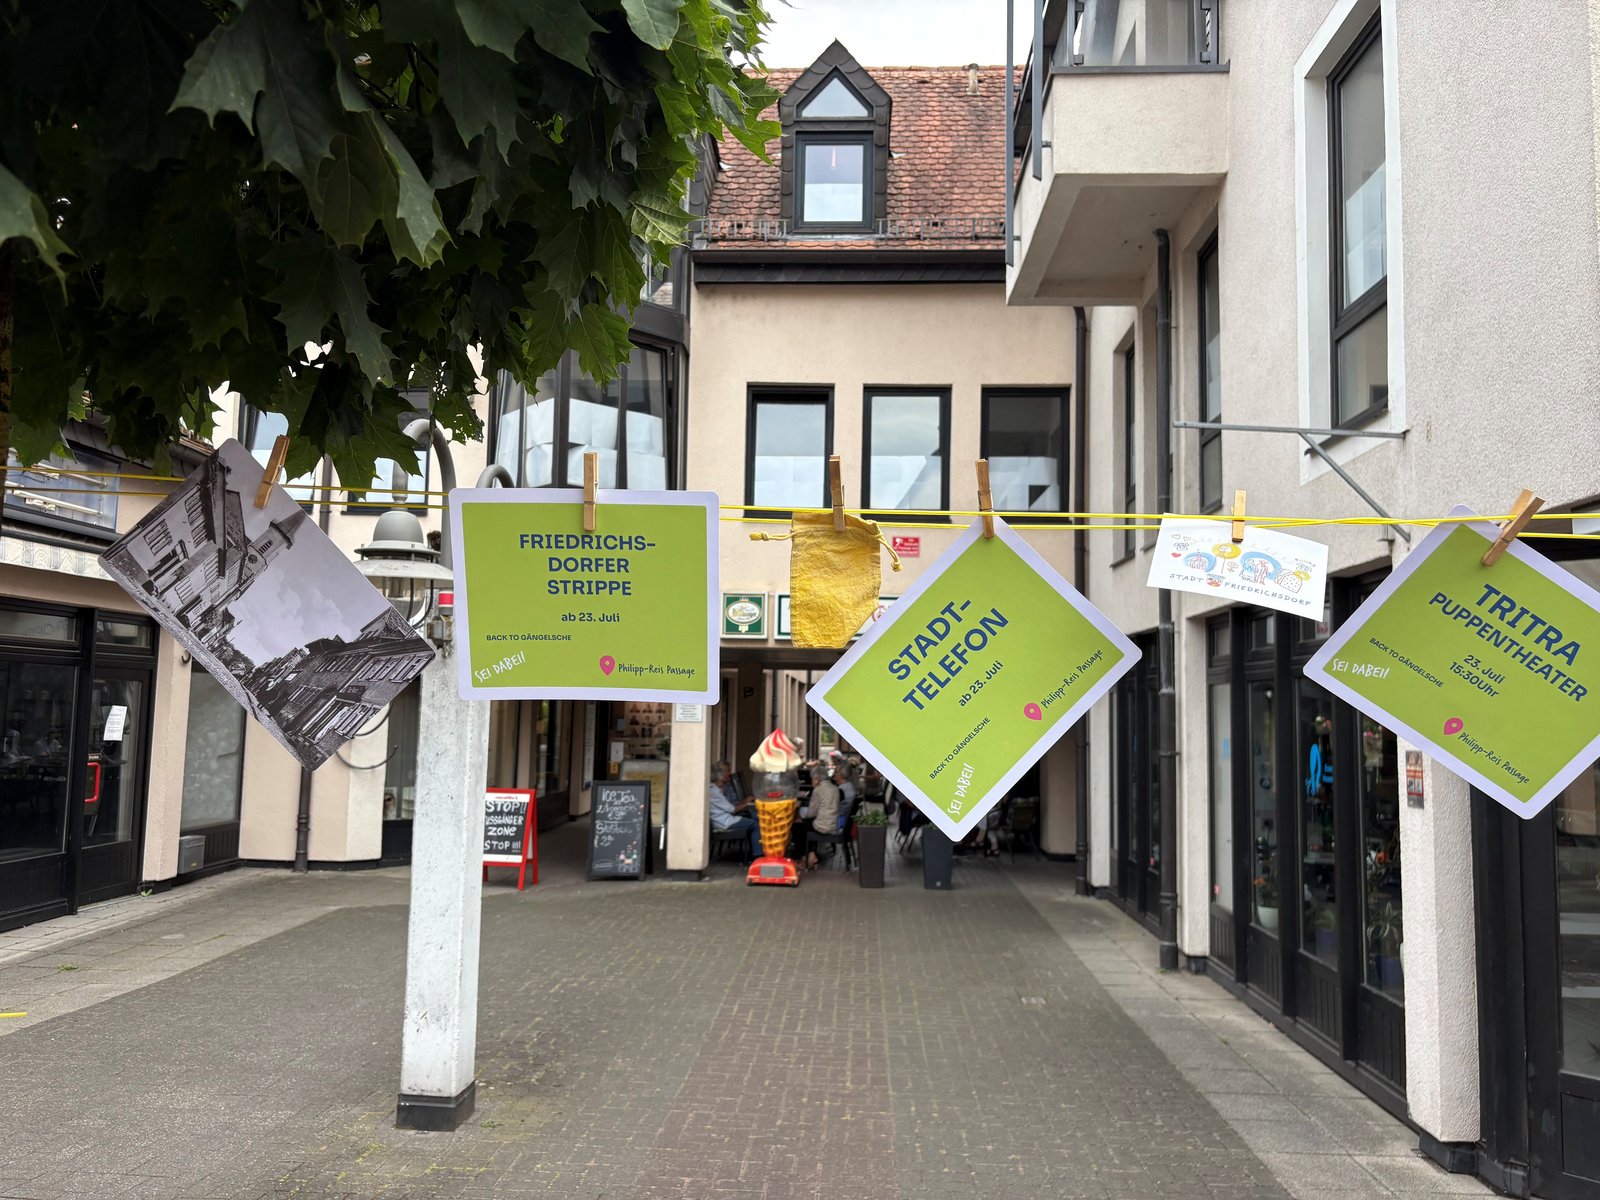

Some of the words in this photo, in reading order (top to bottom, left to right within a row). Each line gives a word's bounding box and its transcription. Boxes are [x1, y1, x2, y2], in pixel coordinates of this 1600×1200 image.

[519, 534, 656, 551] FRIEDRICHS-
[548, 557, 630, 573] DORFER
[547, 579, 632, 596] STRIPPE
[1169, 573, 1204, 583] STADT
[1224, 582, 1312, 606] FRIEDRICHSDORF
[561, 612, 576, 622] ab
[579, 612, 597, 623] 23.
[598, 612, 621, 623] Juli
[1474, 583, 1581, 666] TRITRA
[486, 633, 508, 642] BACK
[508, 633, 520, 642] TO
[520, 632, 572, 642] GÄNGELSCHE
[887, 599, 972, 681] STADT-
[1428, 591, 1589, 703] PUPPENTHEATER
[474, 668, 491, 683] SEI
[493, 651, 526, 676] DABEI!
[618, 662, 664, 677] Philipp-Reis
[666, 663, 695, 679] Passage
[902, 607, 1010, 711] TELEFON
[1331, 657, 1350, 673] SEI
[1352, 662, 1390, 681] DABEI!
[1368, 636, 1390, 655] BACK
[1388, 647, 1401, 660] TO
[1398, 652, 1444, 688] GÄNGELSCHE
[1463, 654, 1481, 670] 23.
[1480, 664, 1507, 685] Juli
[958, 690, 973, 708] ab
[970, 680, 988, 696] 23.
[986, 659, 1004, 681] Juli
[1040, 671, 1079, 709] Philipp-Reis
[1076, 648, 1104, 675] Passage
[928, 761, 947, 780] BACK
[943, 753, 955, 764] TO
[952, 716, 991, 755] GÄNGELSCHE
[1457, 730, 1503, 767] Philipp-Reis
[1501, 758, 1530, 785] Passage
[947, 796, 961, 816] SEI
[956, 762, 976, 798] DABEI!
[483, 839, 511, 851] STOP
